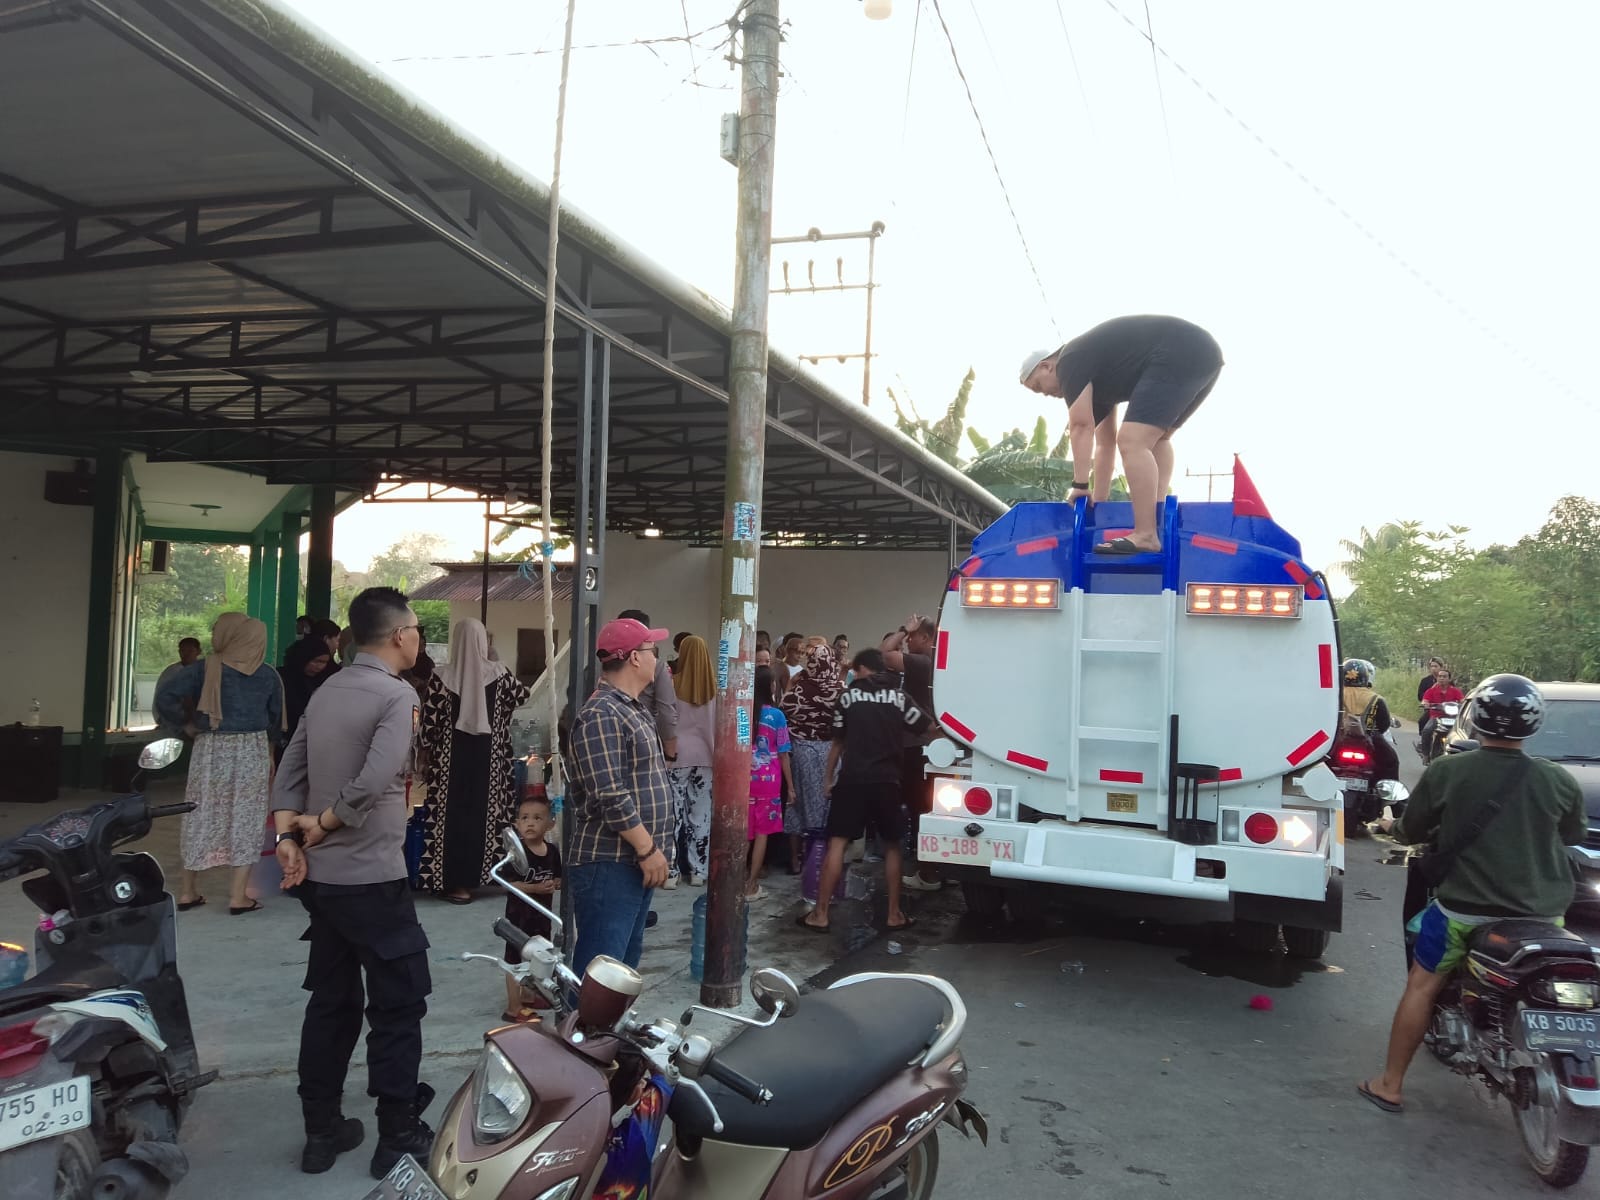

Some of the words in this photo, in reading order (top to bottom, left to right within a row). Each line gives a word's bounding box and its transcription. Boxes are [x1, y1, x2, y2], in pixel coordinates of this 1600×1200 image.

[920, 835, 940, 853] KB
[951, 838, 979, 857] 188
[992, 841, 1013, 860] YX
[1525, 1013, 1550, 1030] KB
[1554, 1015, 1597, 1033] 5035
[22, 1110, 84, 1137] 02-30
[388, 1159, 416, 1191] KB
